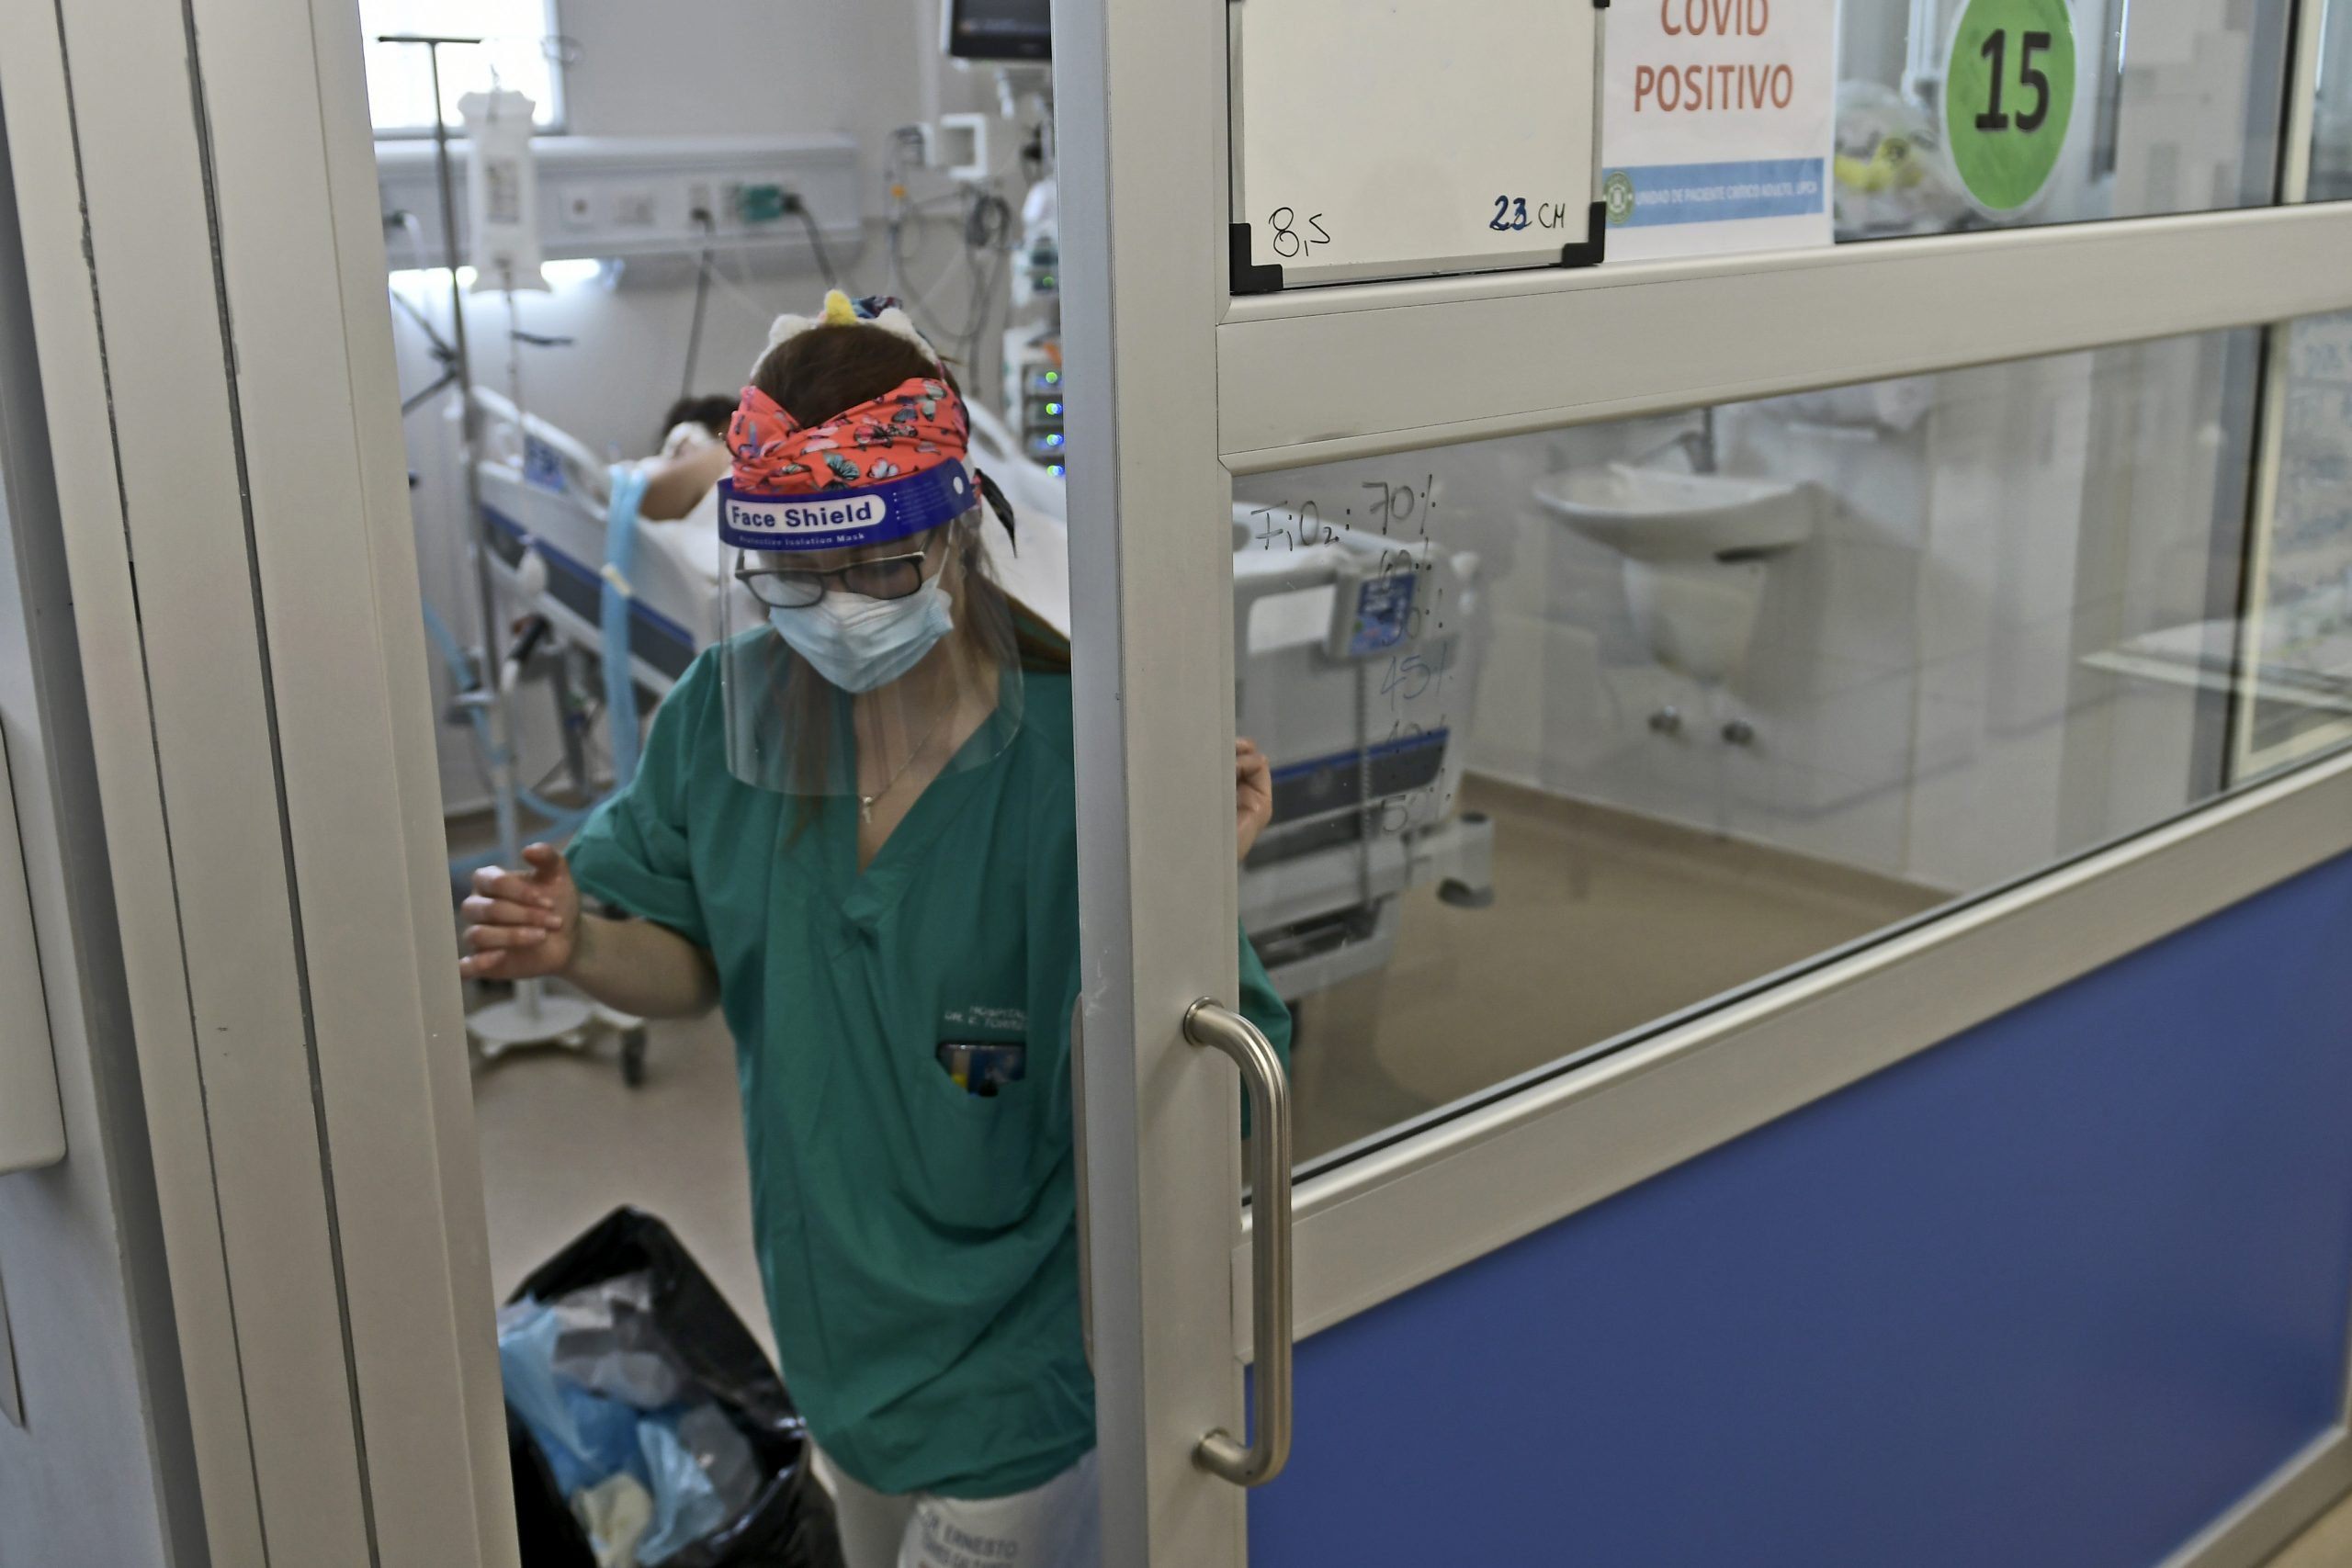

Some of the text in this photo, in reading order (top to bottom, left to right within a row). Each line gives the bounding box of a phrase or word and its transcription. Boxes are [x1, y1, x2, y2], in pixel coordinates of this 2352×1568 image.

[1661, 0, 1769, 36] COVID
[1634, 64, 1793, 112] POSITIVO
[1974, 28, 2052, 133] 15
[1489, 195, 1566, 231] 23 CM
[731, 505, 775, 527] Face
[785, 502, 872, 527] Shield
[1362, 474, 1437, 535] 70%
[786, 536, 832, 546] Isolation
[836, 532, 865, 543] Mask
